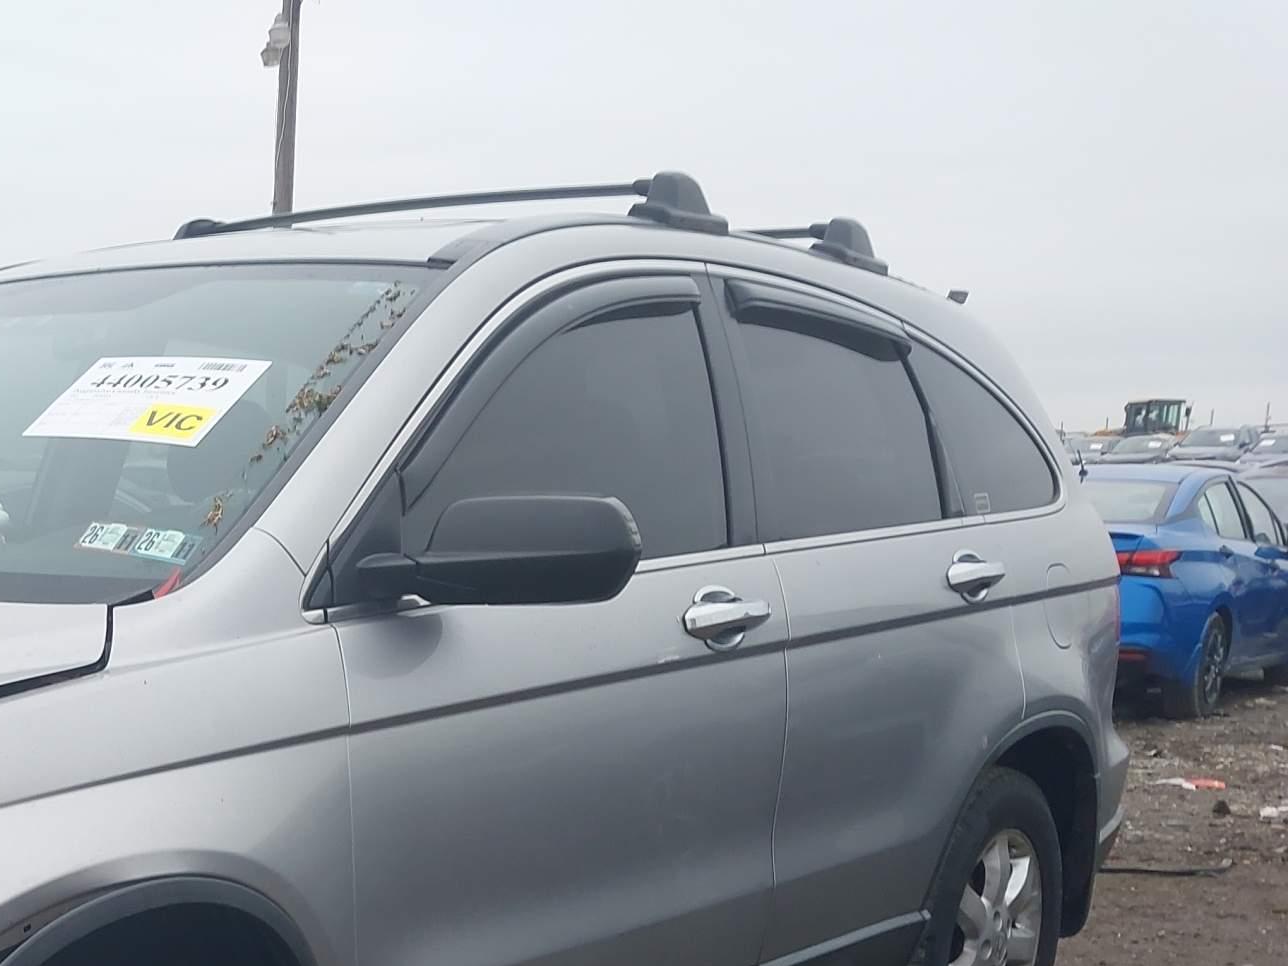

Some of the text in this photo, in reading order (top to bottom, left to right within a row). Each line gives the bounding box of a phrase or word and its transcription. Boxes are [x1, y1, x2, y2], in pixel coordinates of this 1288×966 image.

[91, 373, 229, 391] 44005739
[146, 410, 203, 431] VIC
[82, 524, 105, 544] 26
[136, 531, 160, 552] 26
